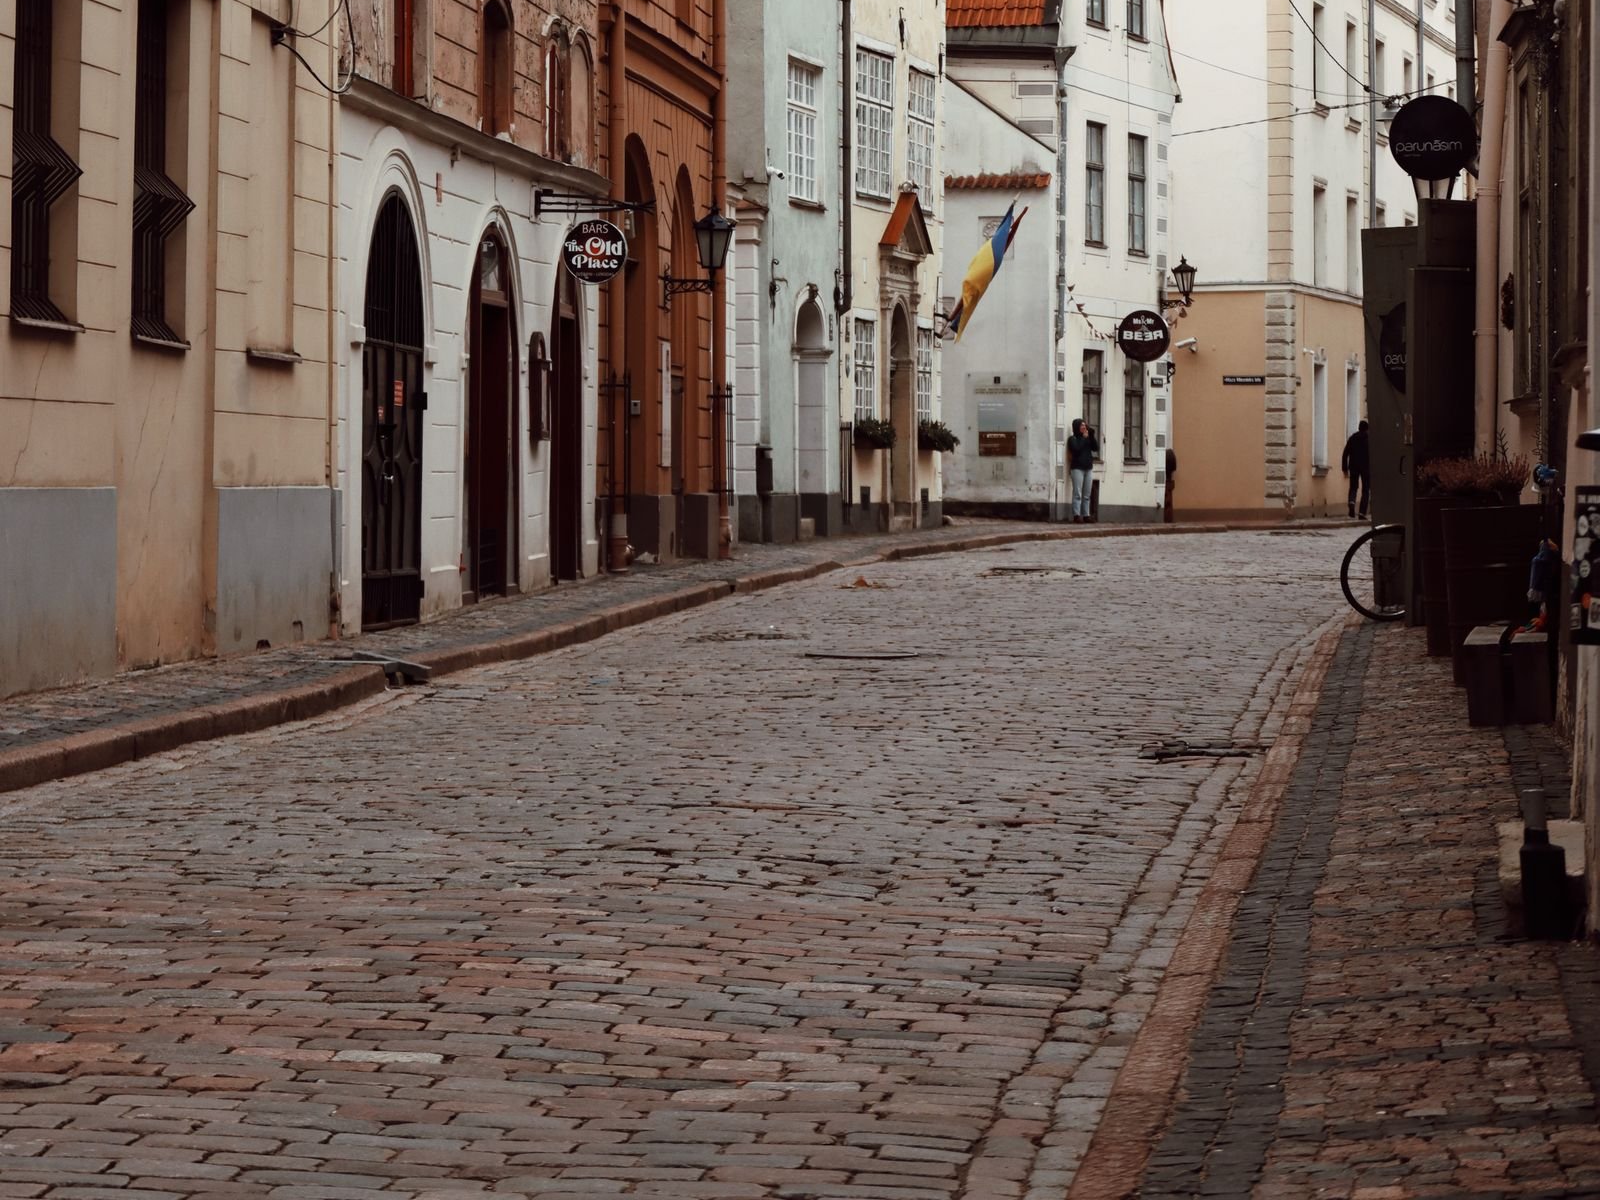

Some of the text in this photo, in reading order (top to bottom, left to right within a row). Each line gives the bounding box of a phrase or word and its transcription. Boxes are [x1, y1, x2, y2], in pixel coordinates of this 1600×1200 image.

[1395, 140, 1462, 154] parunāsim
[565, 236, 622, 255] The Old
[571, 254, 618, 268] Place
